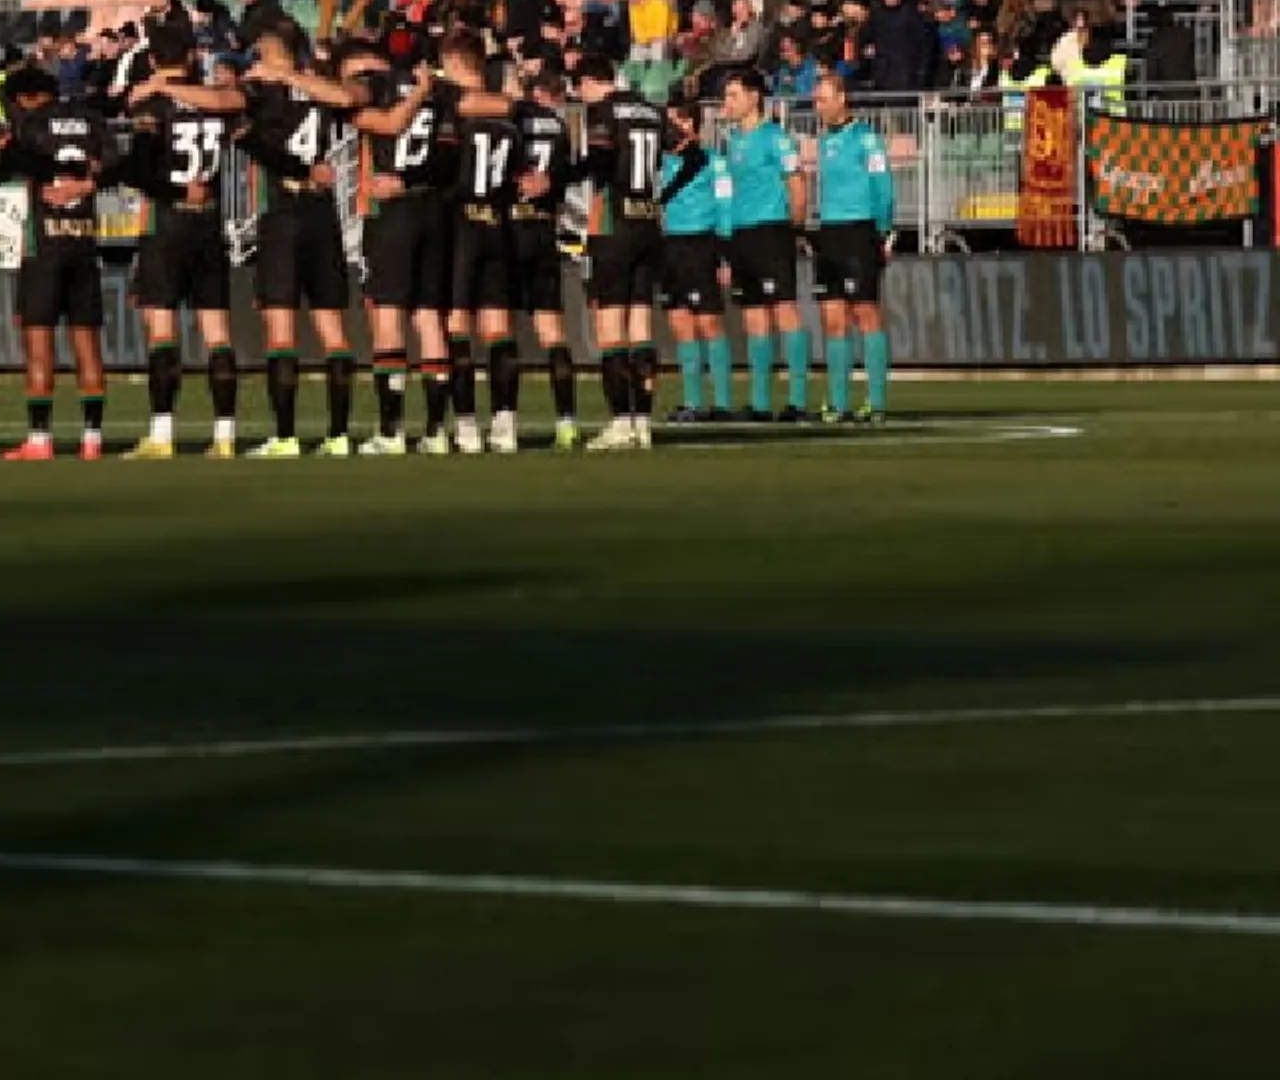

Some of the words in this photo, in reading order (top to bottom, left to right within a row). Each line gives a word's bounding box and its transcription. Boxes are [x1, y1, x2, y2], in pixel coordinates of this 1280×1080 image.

[285, 107, 321, 166] 4
[629, 128, 658, 193] 11
[1061, 256, 1110, 360] LO
[1125, 255, 1278, 360] SPRITZ
